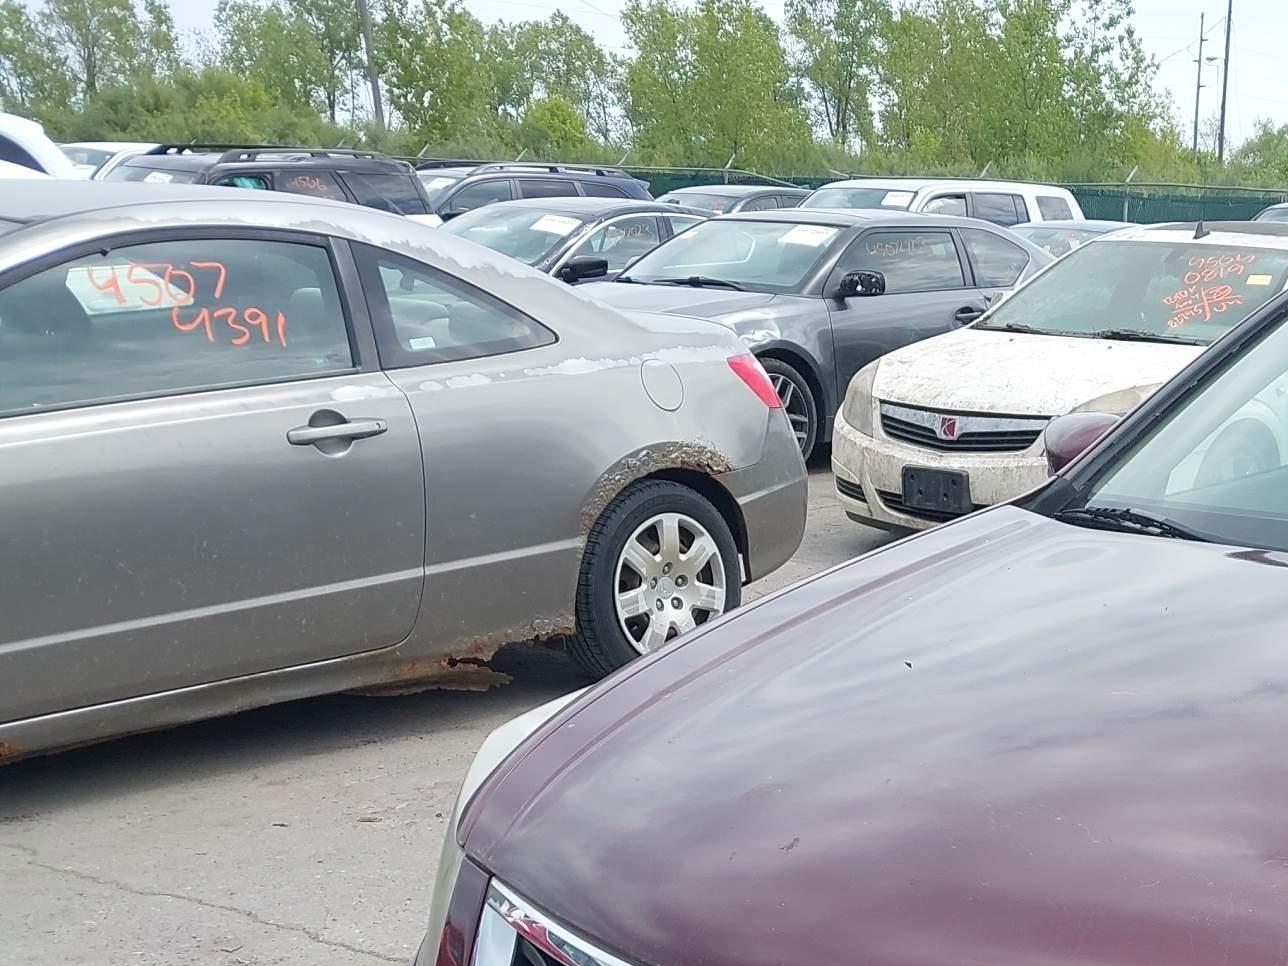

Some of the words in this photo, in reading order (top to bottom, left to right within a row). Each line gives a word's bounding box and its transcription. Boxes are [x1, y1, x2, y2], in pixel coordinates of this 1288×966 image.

[87, 260, 227, 307] 4507
[1183, 263, 1245, 285] 0819
[171, 306, 287, 349] 4391
